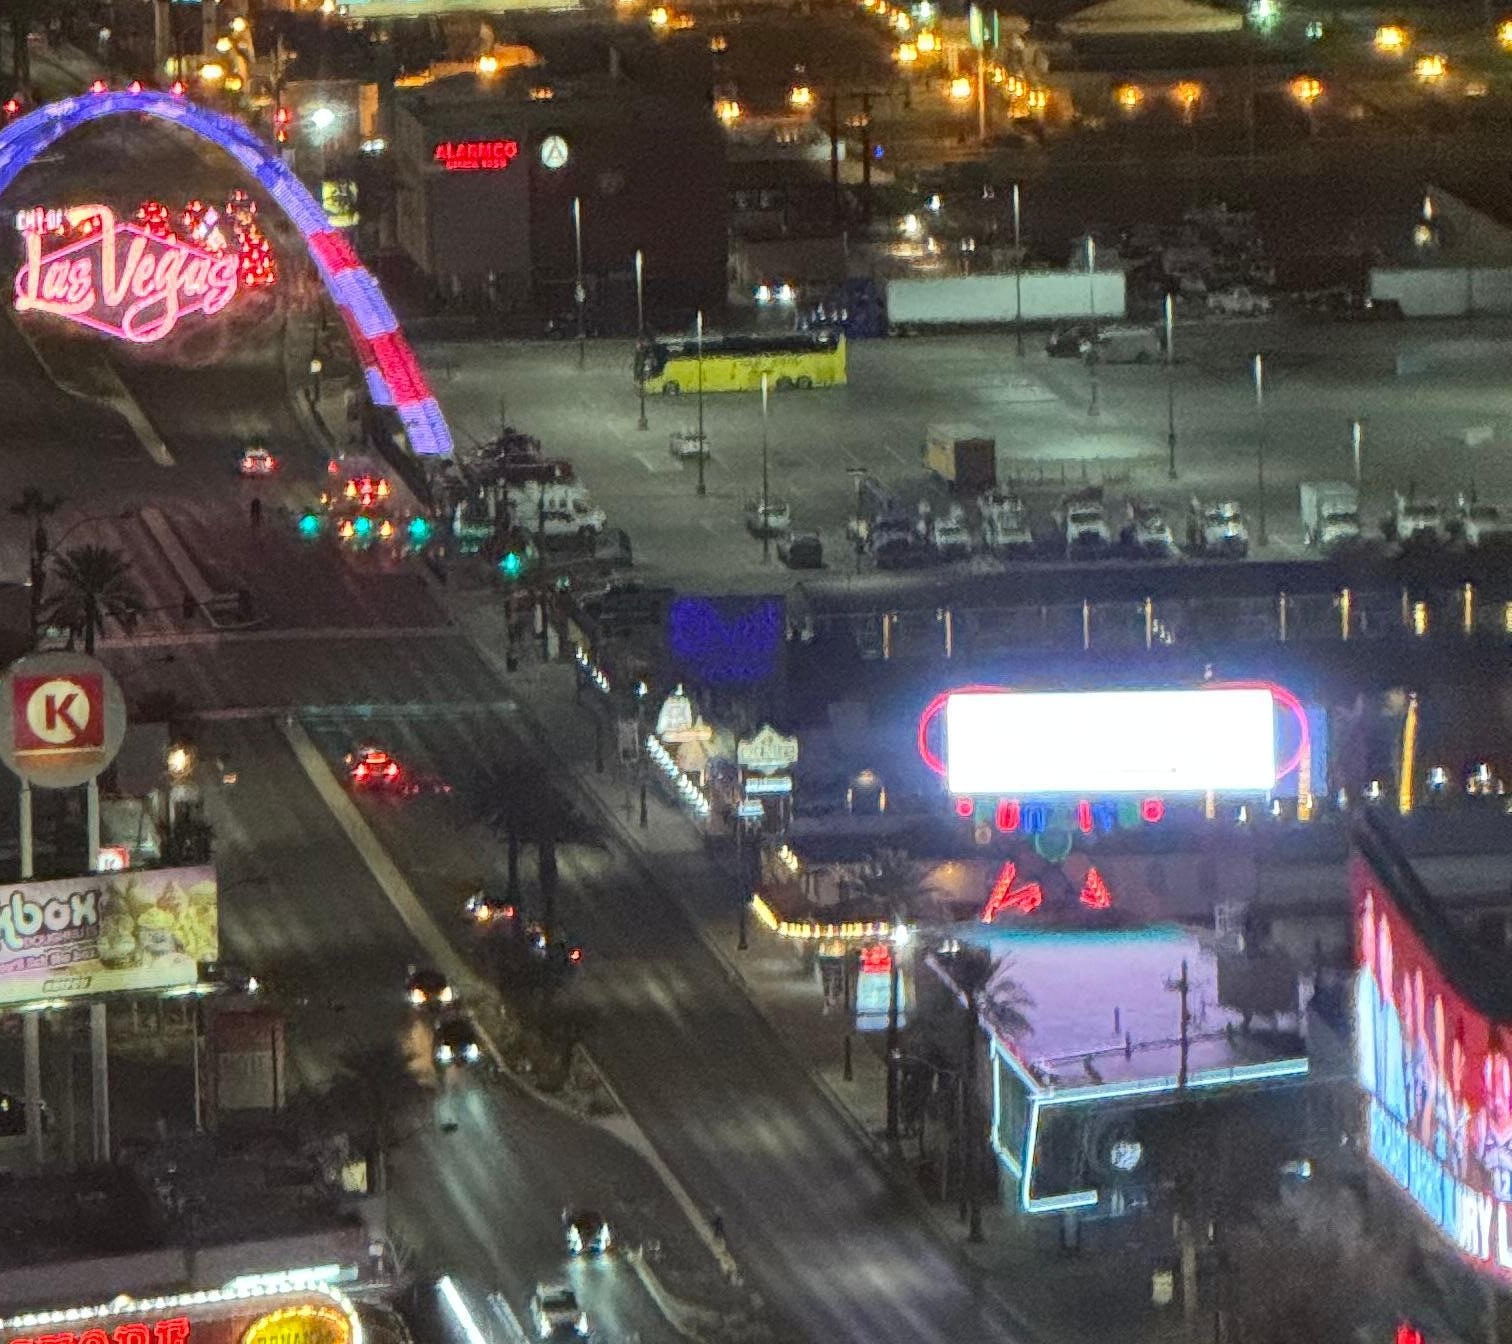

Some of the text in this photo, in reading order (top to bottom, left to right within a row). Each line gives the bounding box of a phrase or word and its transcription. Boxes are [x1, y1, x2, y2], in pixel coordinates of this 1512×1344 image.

[15, 204, 239, 343] Las Vegas
[45, 692, 85, 739] K
